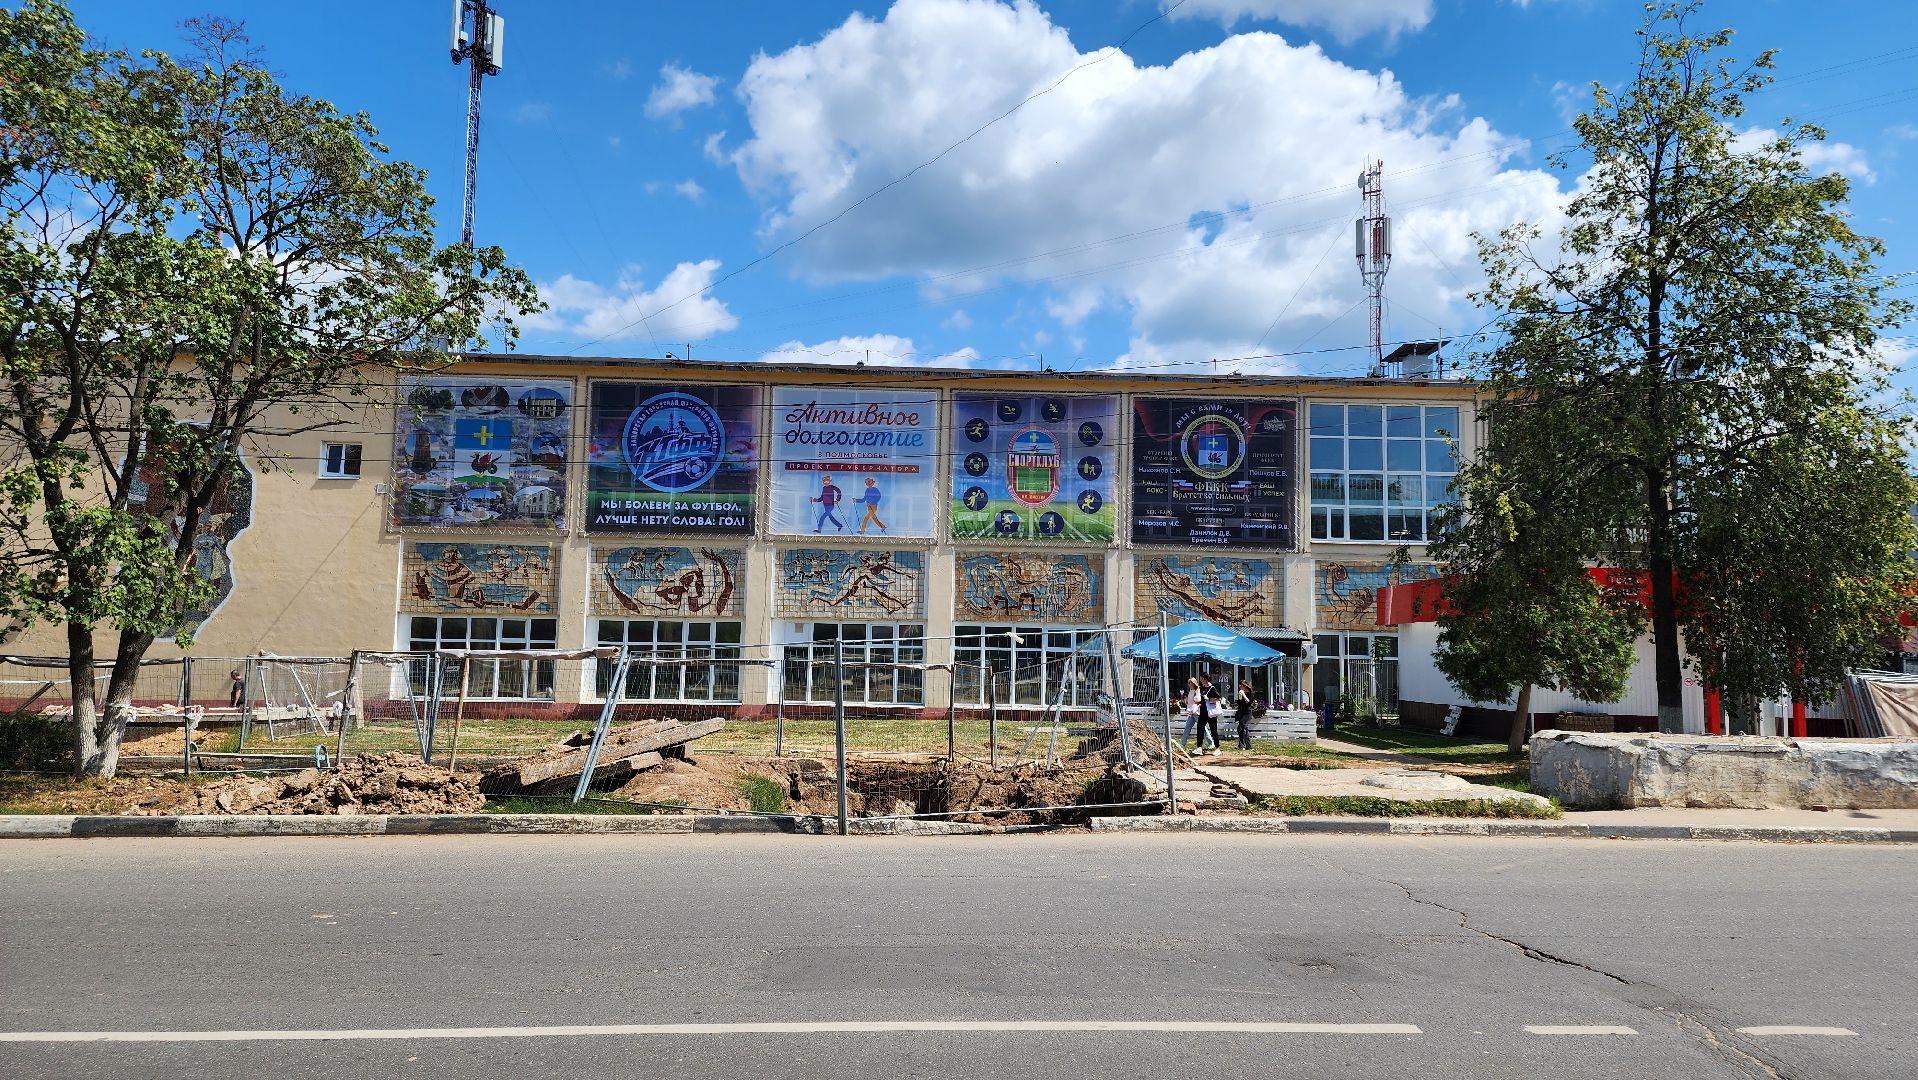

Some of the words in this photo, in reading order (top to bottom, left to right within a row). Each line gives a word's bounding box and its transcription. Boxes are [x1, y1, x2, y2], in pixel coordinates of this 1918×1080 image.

[785, 400, 921, 426] Активное
[1176, 412, 1190, 428] МЫ
[785, 420, 925, 447] долголетие
[1008, 453, 1060, 468] СПОРТКЛУБ
[840, 464, 917, 472] ГУБЕРНАТОРА
[1194, 481, 1229, 492] ФБКК
[601, 500, 621, 508] МЫ
[625, 500, 671, 510] БОЛЕЕМ
[674, 502, 689, 510] ЗА
[691, 502, 742, 512] ФУТБОЛ,
[596, 515, 637, 524] ЛУЧШЕ
[641, 515, 669, 525] НЕТУ
[672, 516, 715, 525] СЛОВА:
[718, 516, 745, 526] ГОЛ!
